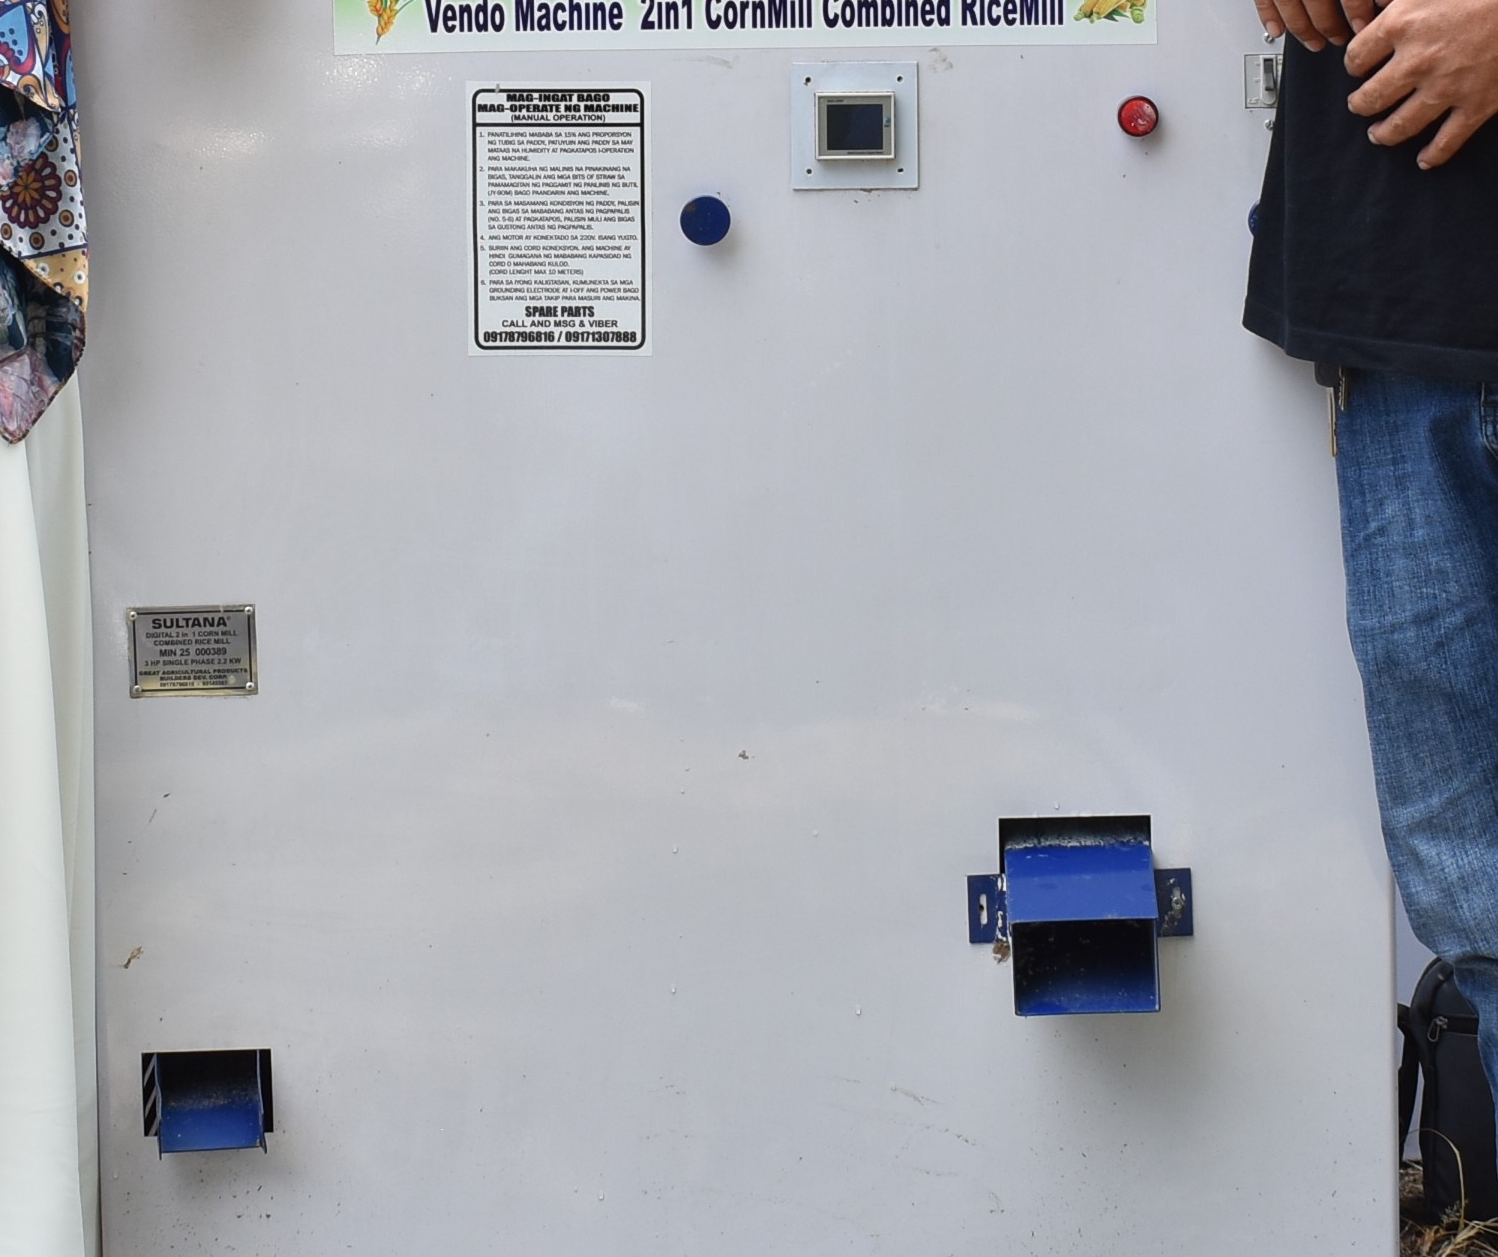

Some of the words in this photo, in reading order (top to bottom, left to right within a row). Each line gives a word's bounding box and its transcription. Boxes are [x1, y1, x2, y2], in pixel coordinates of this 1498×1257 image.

[506, 94, 574, 102] MAG-INGAT
[577, 94, 610, 102] BAGO
[478, 104, 561, 112] MAG-OPERATE
[564, 104, 580, 112] NG
[584, 104, 639, 112] MACHINE
[525, 306, 558, 317] SPARE
[561, 306, 594, 317] PARTS
[502, 320, 528, 328] CALL
[530, 320, 551, 328] AND
[554, 320, 575, 328] MSG
[579, 320, 585, 328] &
[588, 320, 618, 328] VIBER
[557, 331, 563, 342] /
